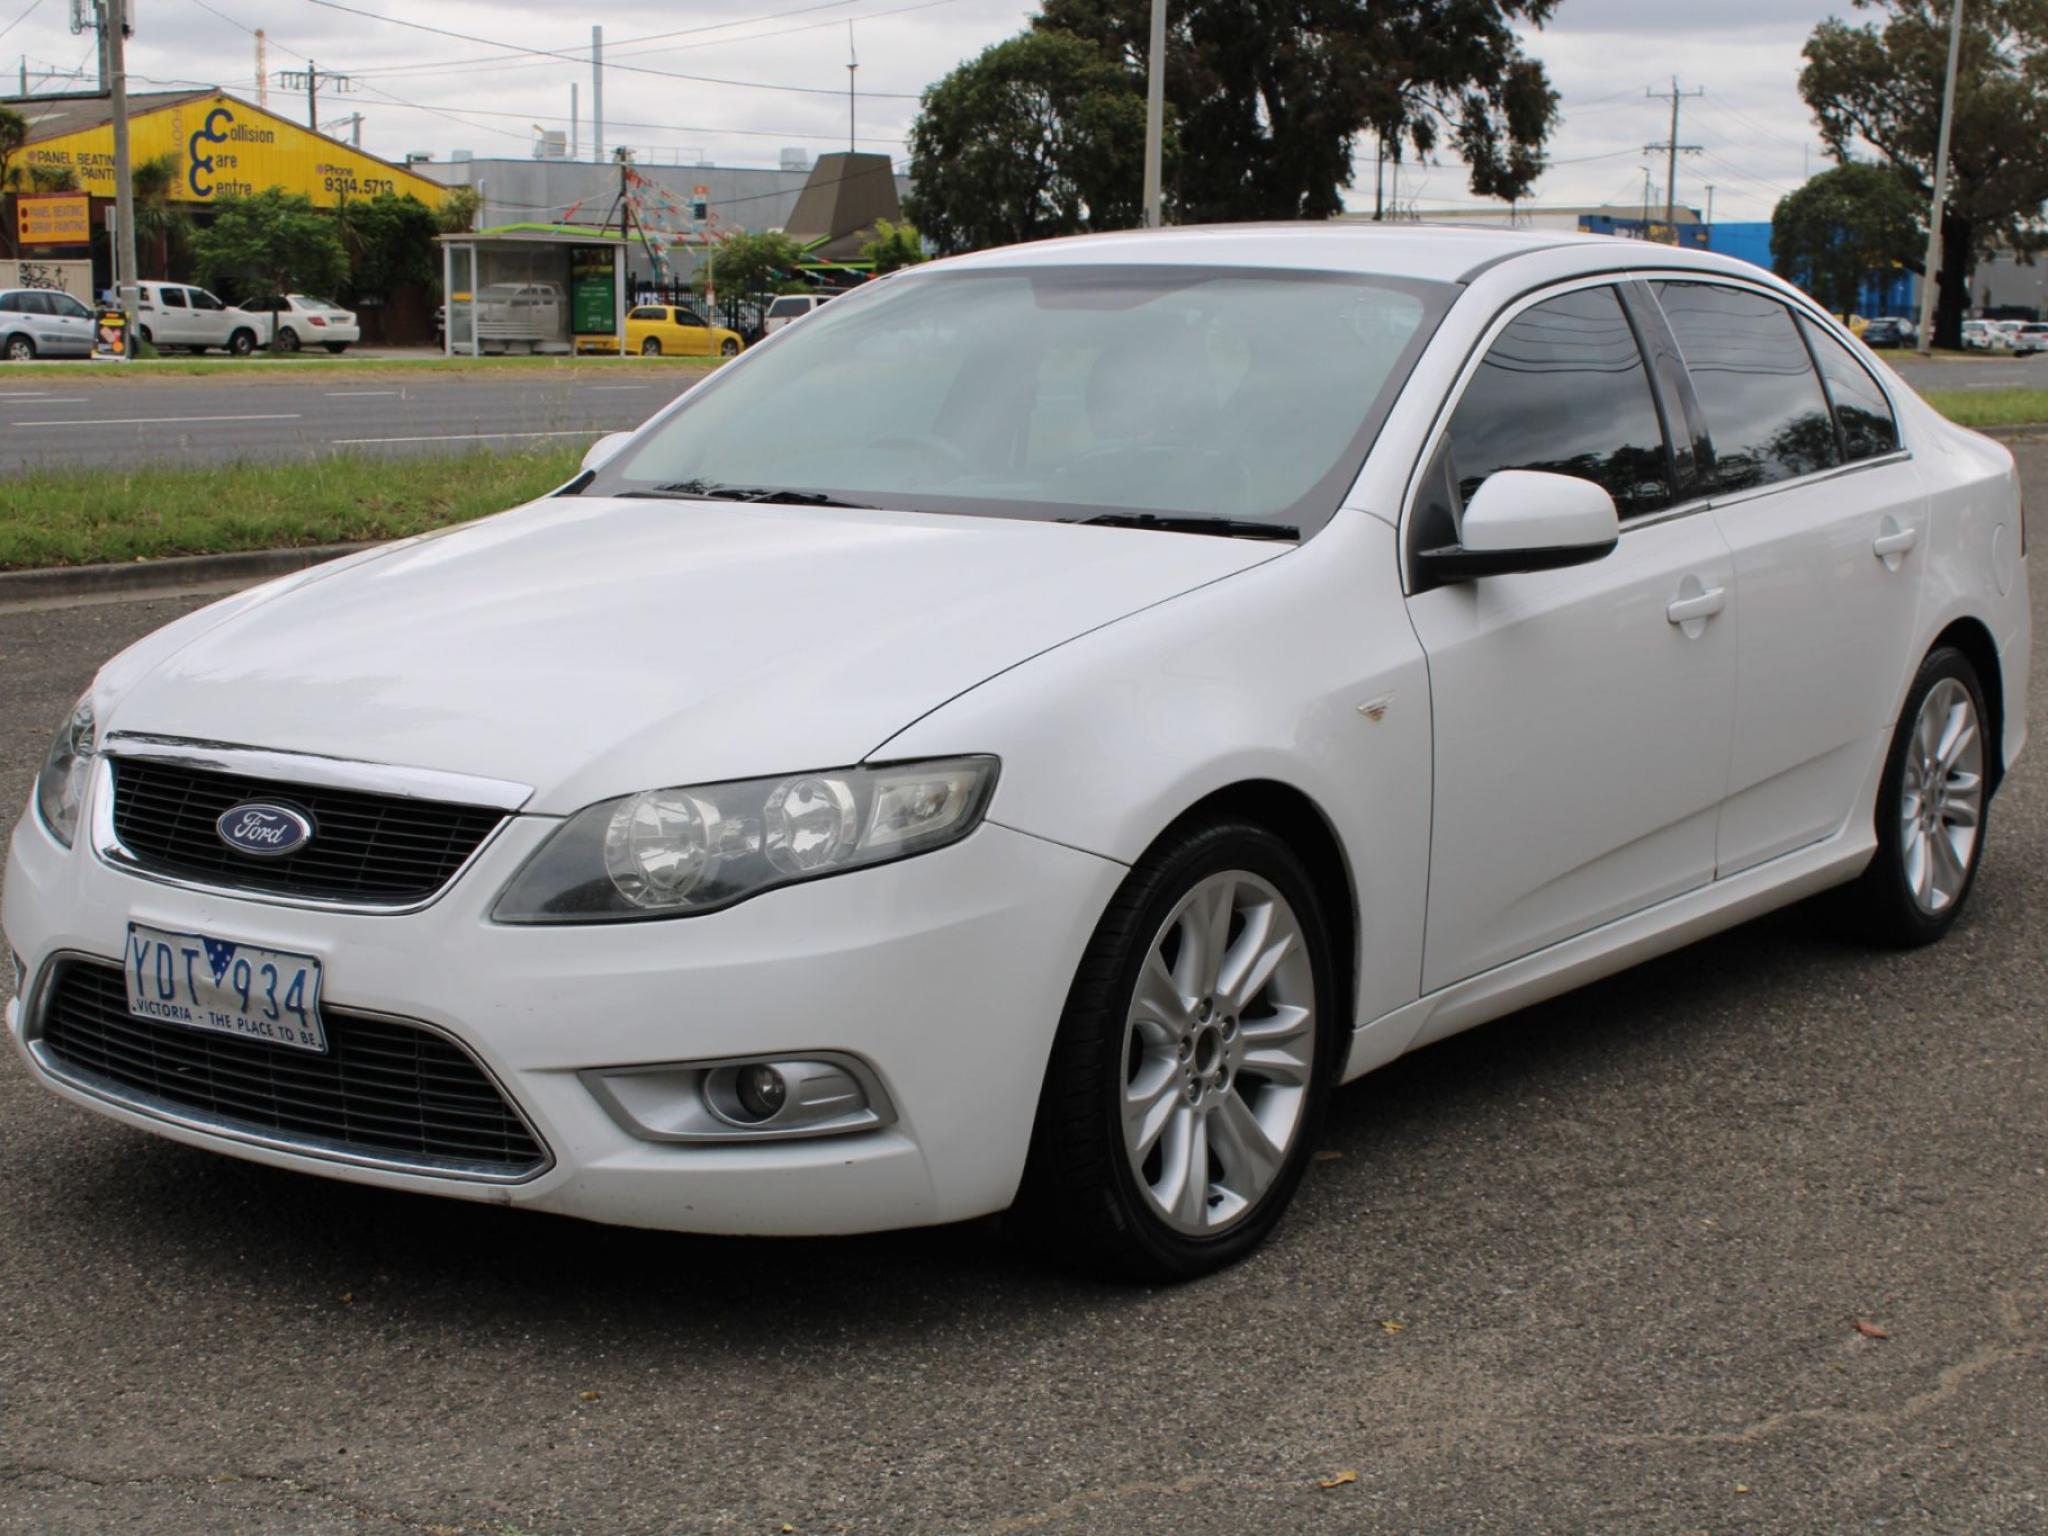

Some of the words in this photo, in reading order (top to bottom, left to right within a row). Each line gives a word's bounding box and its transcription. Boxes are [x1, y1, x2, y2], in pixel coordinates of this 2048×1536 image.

[205, 107, 274, 144] Collision
[37, 151, 72, 164] PANEL
[76, 153, 115, 166] BEATIN
[324, 163, 354, 176] Phone
[324, 177, 394, 195] 9314.5713
[234, 811, 288, 844] Ford
[132, 936, 200, 1006] YDT
[232, 958, 308, 1029] 934
[136, 998, 192, 1020] VICTORIA
[208, 1011, 232, 1029] THE
[237, 1017, 275, 1037] PLACE
[278, 1026, 295, 1042] TO
[300, 1031, 316, 1046] BE
